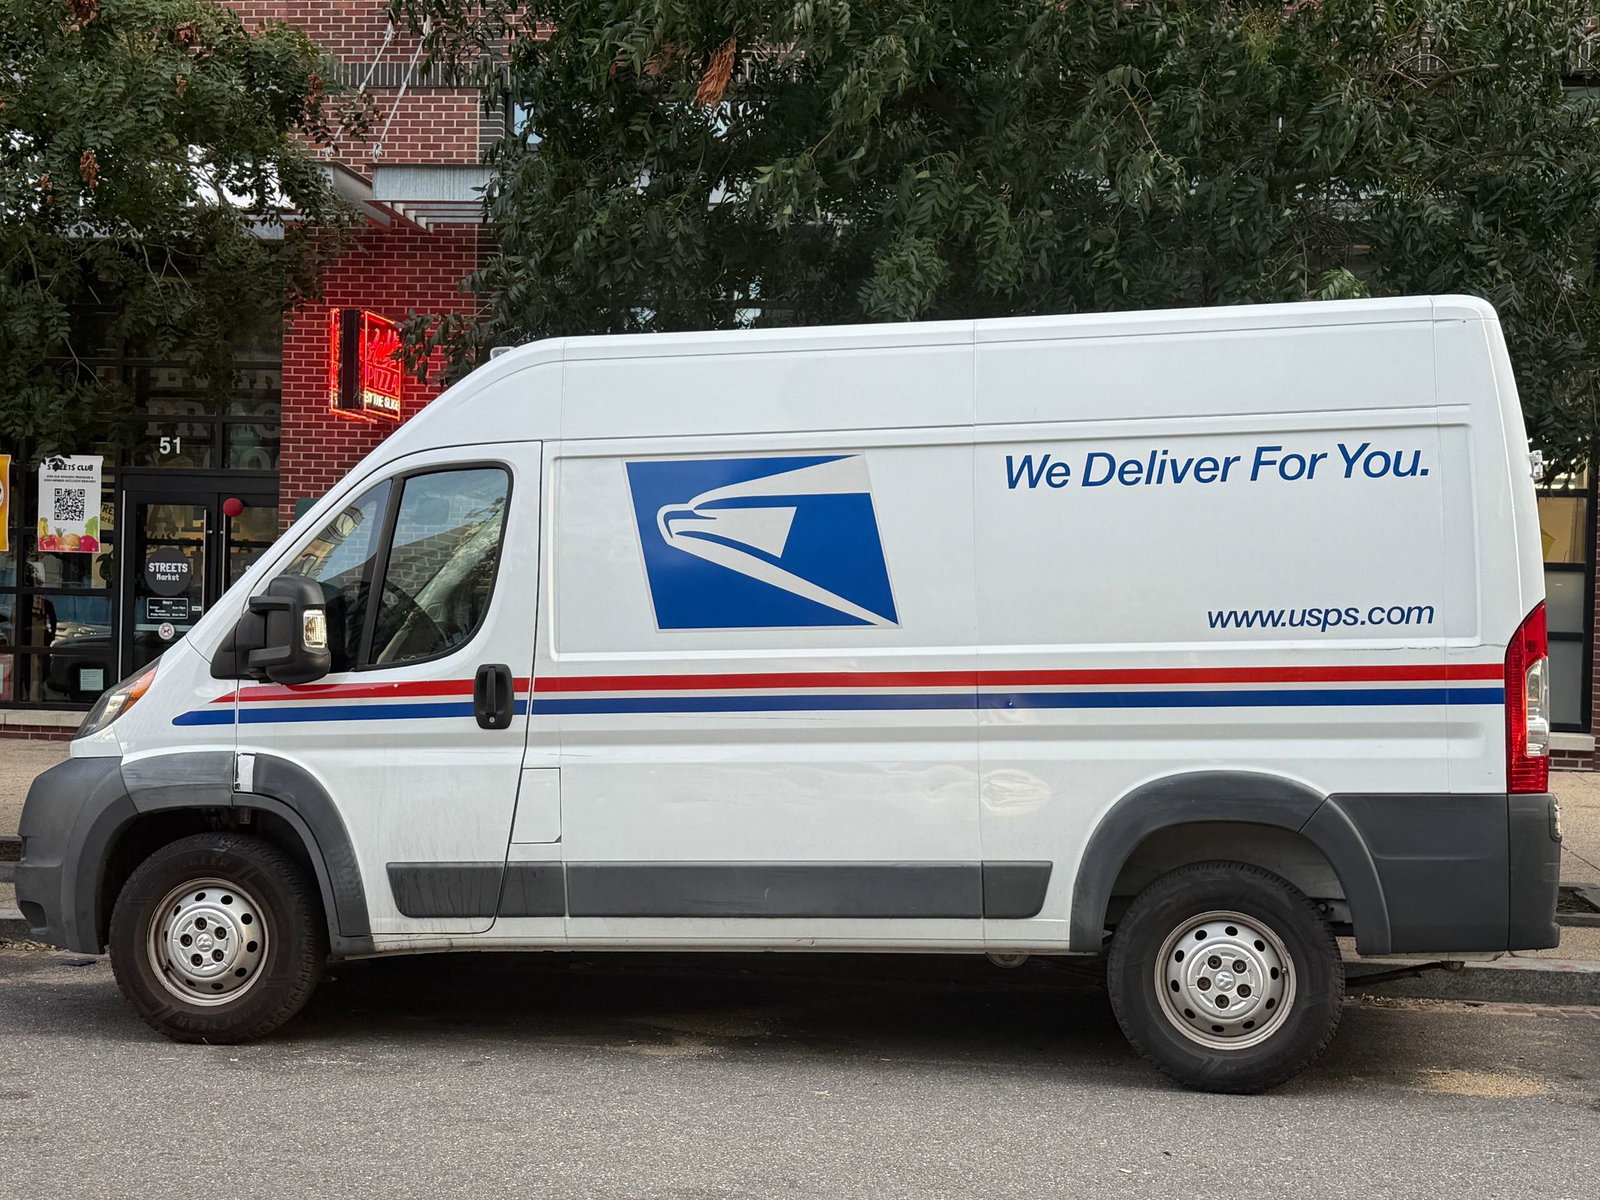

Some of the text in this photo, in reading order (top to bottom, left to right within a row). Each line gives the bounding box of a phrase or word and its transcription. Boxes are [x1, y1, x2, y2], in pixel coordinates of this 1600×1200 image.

[366, 365, 400, 396] PIZZA
[159, 437, 181, 455] 51
[1005, 442, 1429, 489] We Deliver For You.
[148, 562, 188, 573] STREETS
[156, 573, 180, 581] Market
[1207, 605, 1435, 633] www.usps.com
